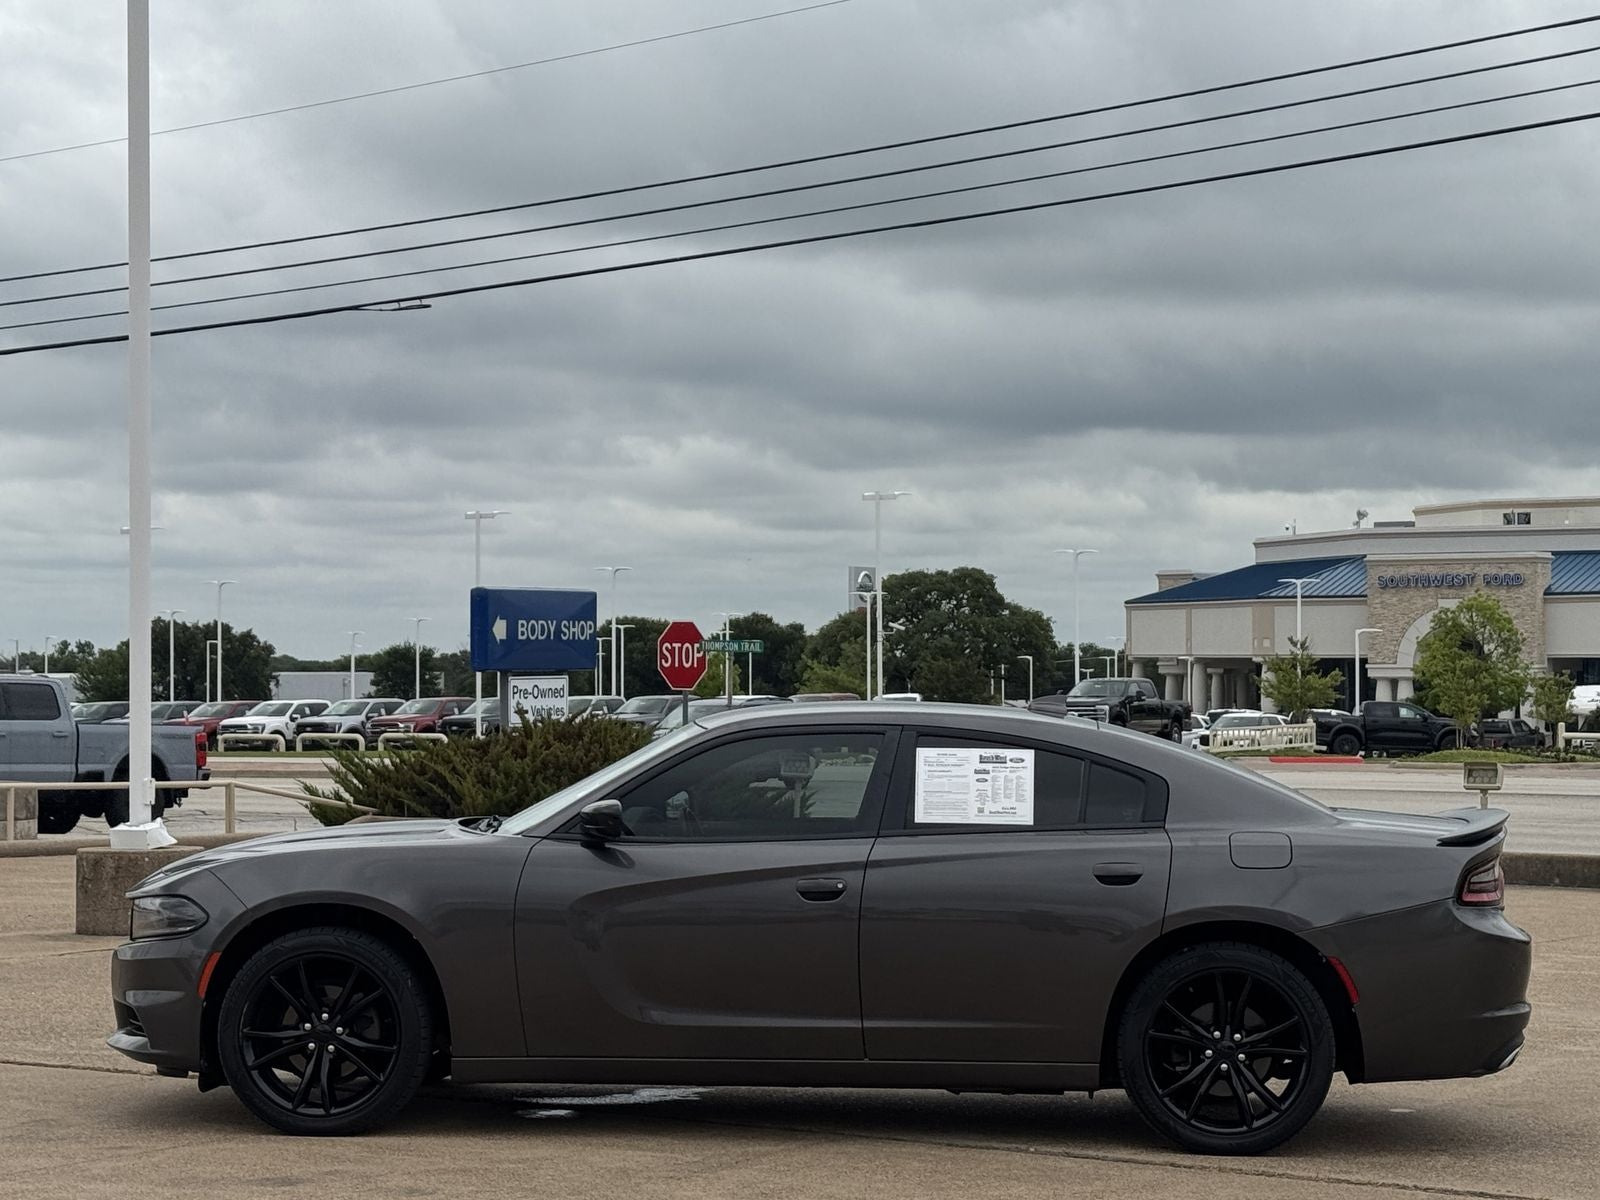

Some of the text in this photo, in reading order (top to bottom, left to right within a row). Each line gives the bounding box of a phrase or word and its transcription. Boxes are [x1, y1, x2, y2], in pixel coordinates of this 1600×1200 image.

[1377, 573, 1524, 588] SOUTHWEST FORD
[518, 620, 594, 640] BODY SHOP
[702, 641, 761, 652] THOMPSON TRAIL
[661, 643, 703, 668] STOP
[512, 684, 565, 700] Pre-Owned
[530, 705, 565, 717] Vehicles
